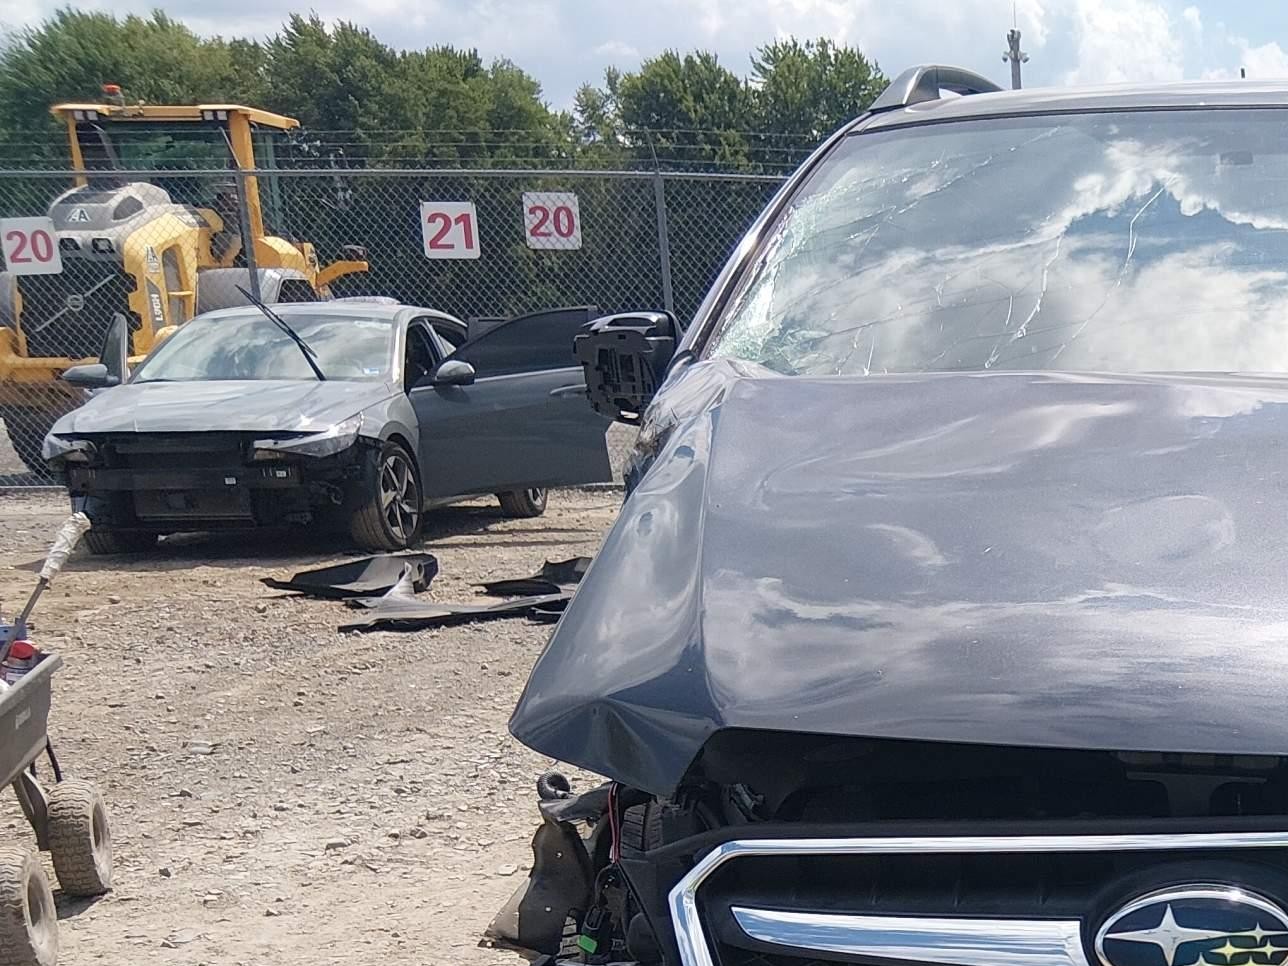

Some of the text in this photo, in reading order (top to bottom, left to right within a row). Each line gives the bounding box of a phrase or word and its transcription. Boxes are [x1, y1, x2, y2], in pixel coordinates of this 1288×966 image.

[427, 212, 474, 250] 21
[528, 205, 575, 238] 20
[6, 229, 54, 263] 20
